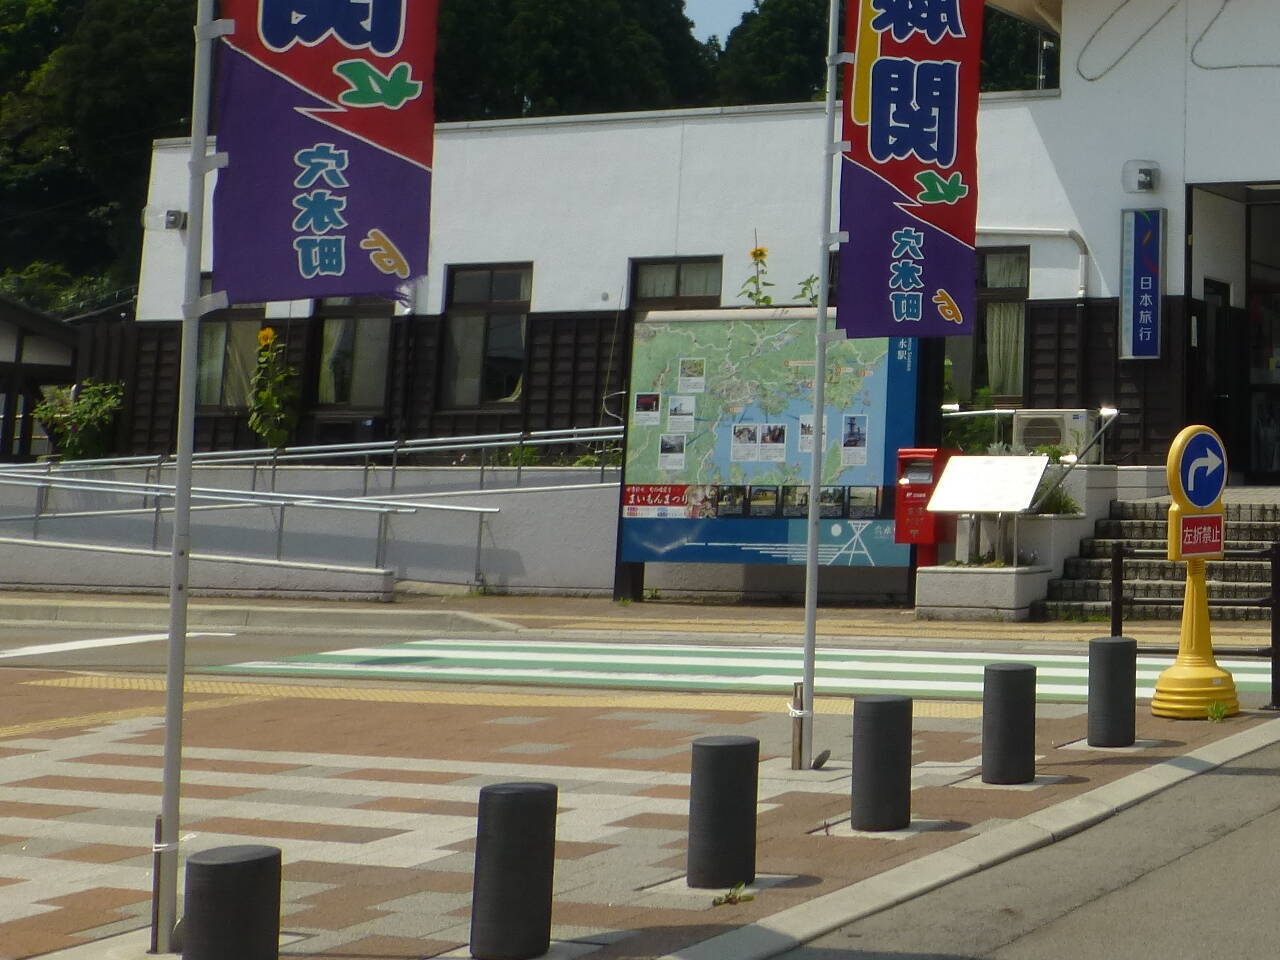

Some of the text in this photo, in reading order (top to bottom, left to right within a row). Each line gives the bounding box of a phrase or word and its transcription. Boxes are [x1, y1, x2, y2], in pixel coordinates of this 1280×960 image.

[1139, 276, 1153, 341] 日本旅行
[629, 493, 688, 504] まいもんまつり
[1183, 525, 1220, 544] 左折禁止
